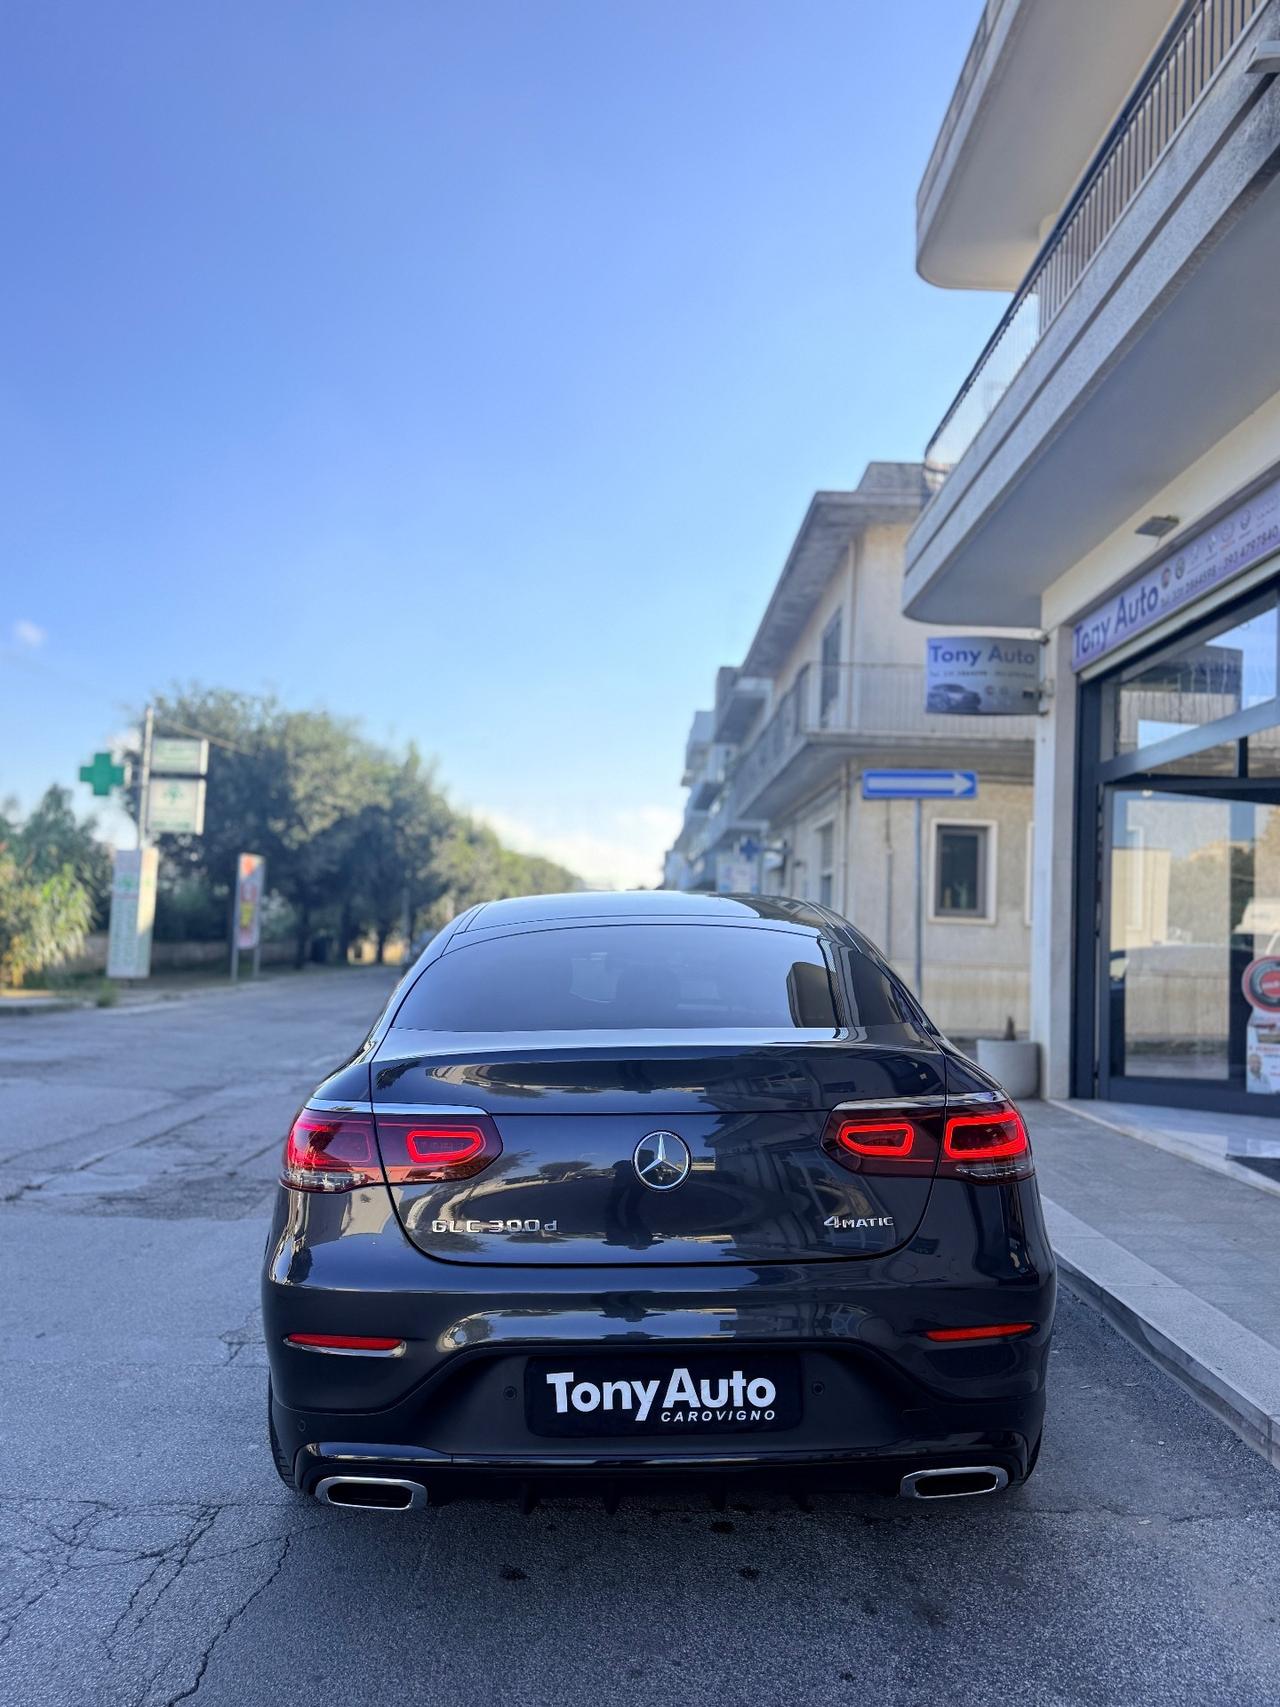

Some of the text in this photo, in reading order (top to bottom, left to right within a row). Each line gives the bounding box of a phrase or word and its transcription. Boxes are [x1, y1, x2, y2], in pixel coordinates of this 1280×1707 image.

[1074, 586, 1159, 658] Tony Auto
[931, 646, 1036, 667] Tony Auto
[431, 1219, 558, 1233] GLC 300d
[823, 1215, 894, 1229] 4MATIC
[661, 1410, 777, 1422] CAROVIGNO
